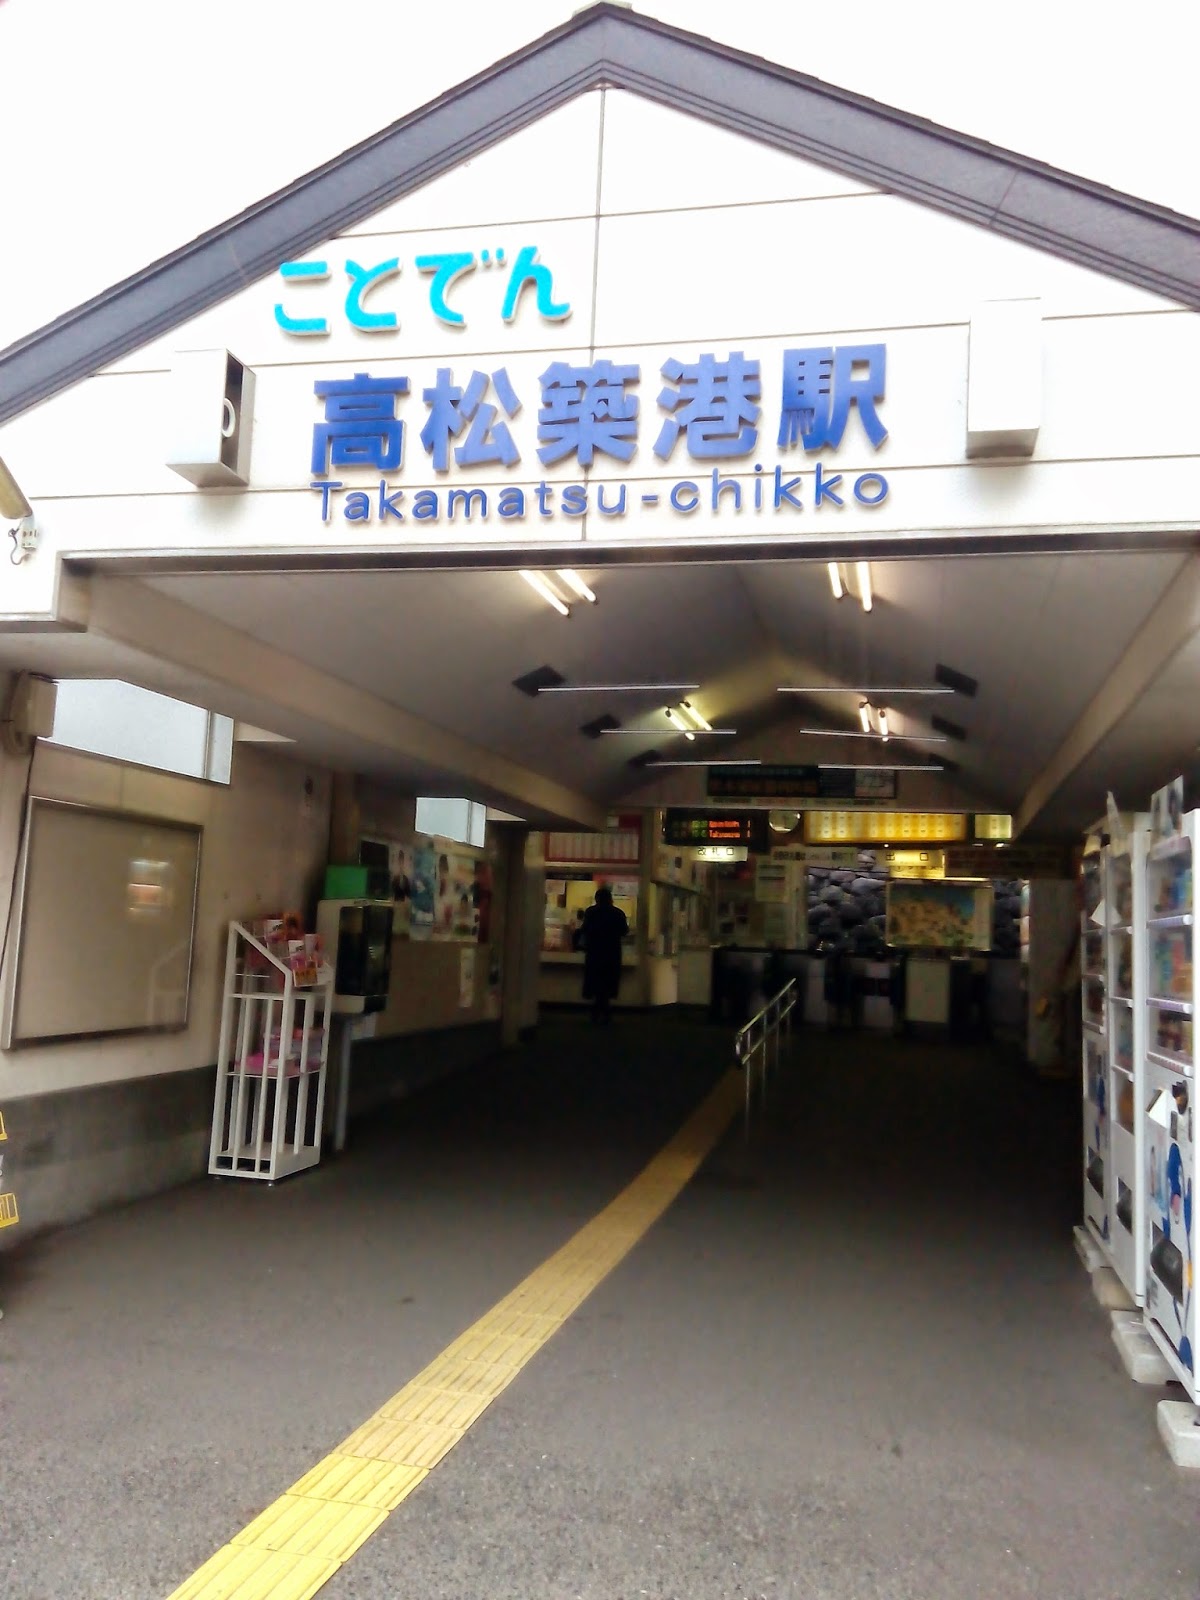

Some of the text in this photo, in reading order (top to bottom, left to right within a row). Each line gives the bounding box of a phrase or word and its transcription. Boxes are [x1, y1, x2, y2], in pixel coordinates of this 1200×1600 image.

[275, 246, 571, 334] ことでん
[311, 343, 888, 475] 高松築港駅
[311, 463, 890, 522] Takamatsu-chikko
